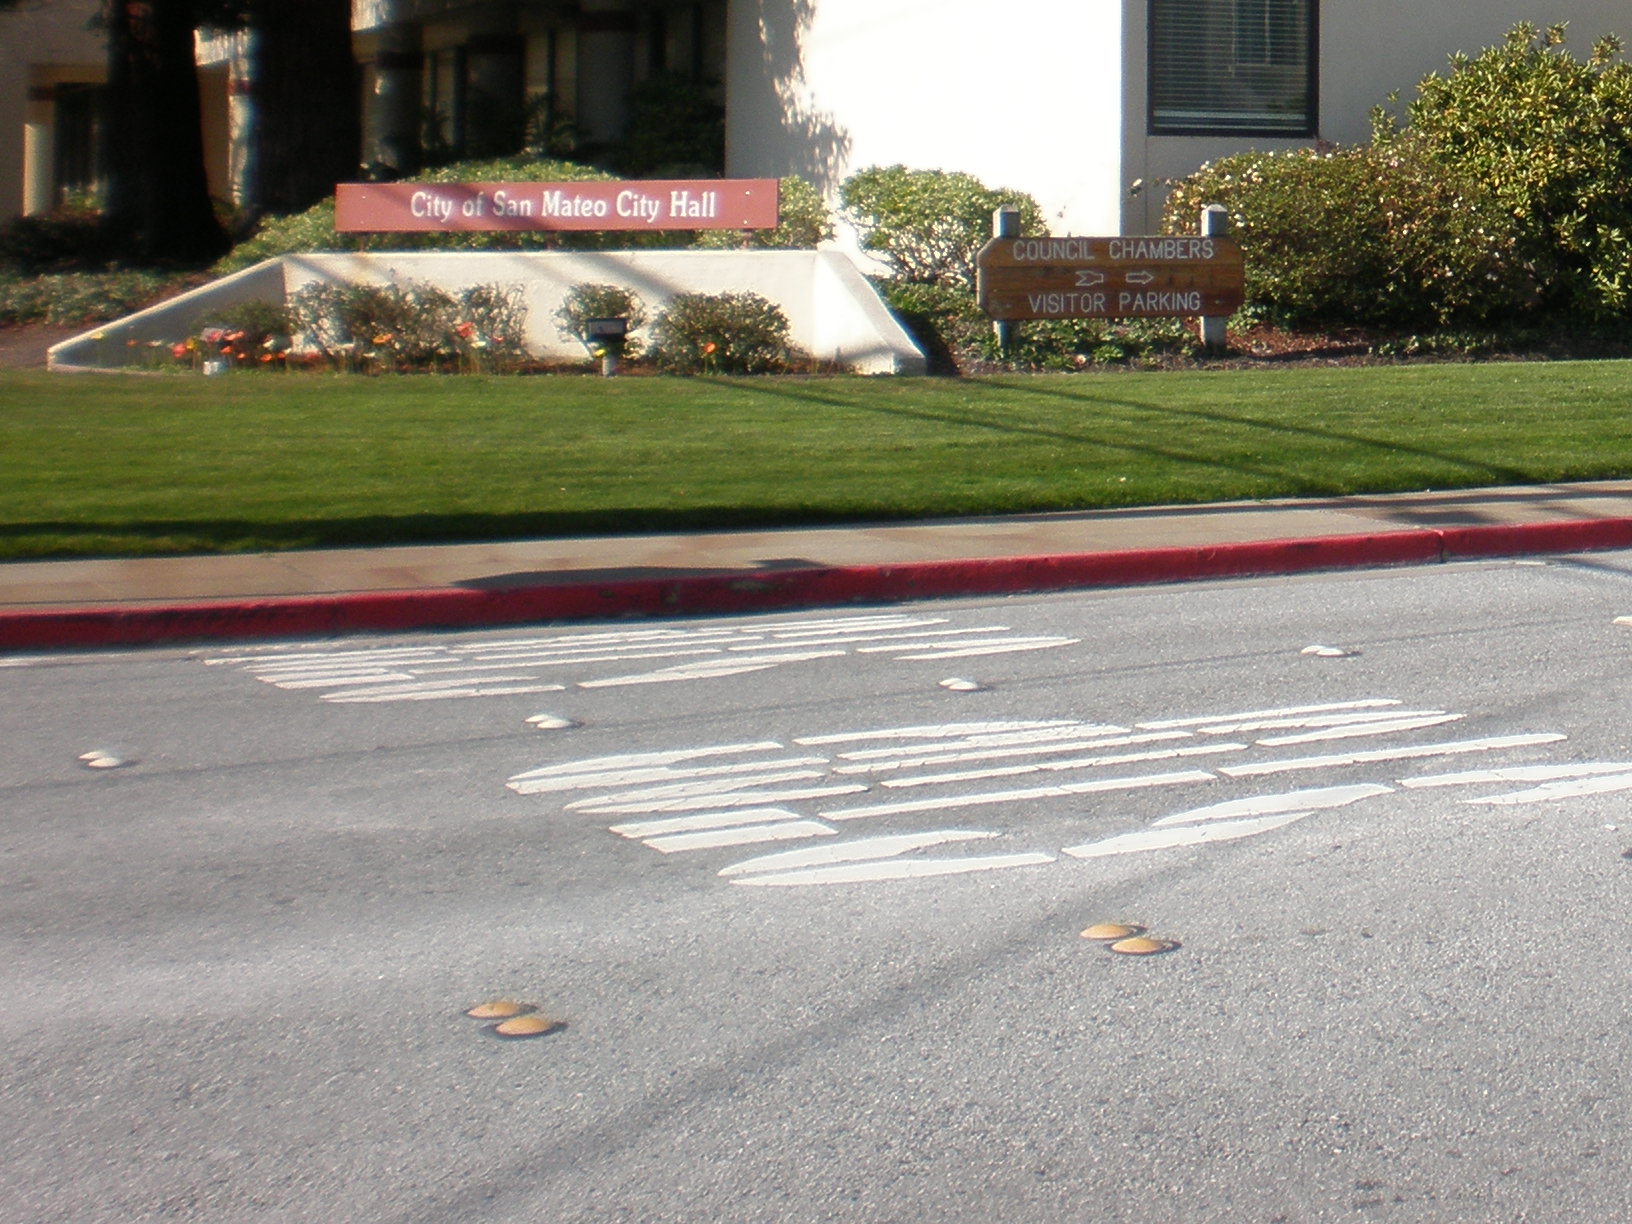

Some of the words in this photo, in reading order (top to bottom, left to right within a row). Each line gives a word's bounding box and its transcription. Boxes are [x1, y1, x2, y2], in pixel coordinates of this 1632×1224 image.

[411, 191, 452, 223] City
[462, 191, 484, 217] of
[492, 191, 532, 216] San
[541, 190, 607, 217] Mateo
[616, 191, 660, 223] City
[670, 191, 717, 218] Hall
[1013, 240, 1095, 261] COUNCIL
[1109, 239, 1214, 260] CHAMBERS
[1028, 293, 1105, 314] VISITOR
[1119, 292, 1201, 312] PARKING
